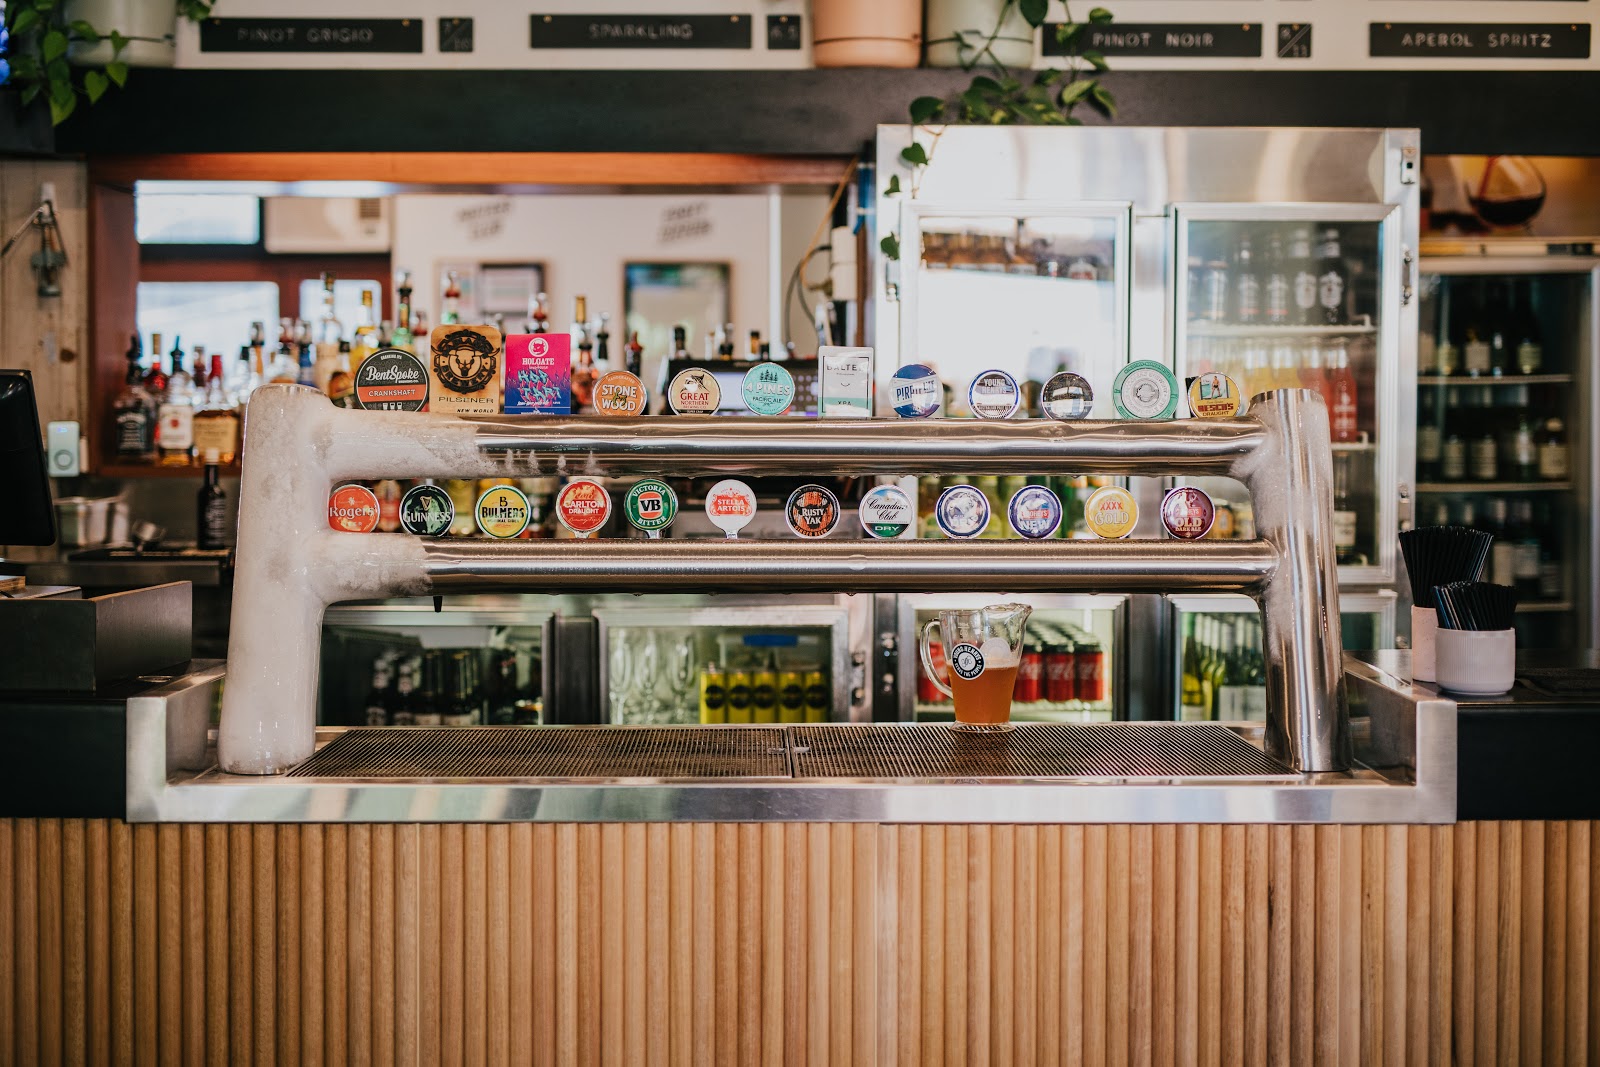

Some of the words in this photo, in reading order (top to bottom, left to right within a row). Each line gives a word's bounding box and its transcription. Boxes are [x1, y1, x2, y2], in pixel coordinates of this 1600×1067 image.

[238, 27, 296, 42] PINOT
[306, 27, 374, 43] GRIGIO
[588, 24, 694, 40] SPARKLING
[1092, 32, 1152, 48] PINOT
[1165, 32, 1214, 48] NOIR
[1401, 32, 1474, 48] APEROL
[1488, 32, 1552, 48] SPRITZ
[522, 357, 555, 366] HOLGATE
[826, 363, 864, 372] BALTE
[365, 365, 419, 384] BentSpoke
[983, 378, 1006, 387] YOUNG
[368, 389, 416, 398] CRANKSHAFT
[601, 384, 638, 398] STONE
[746, 382, 754, 393] 4
[756, 382, 790, 396] PINES
[438, 396, 494, 404] PILSENER
[680, 392, 709, 400] GREAT
[601, 398, 637, 411] WOOD
[632, 484, 667, 497] VICTORIA
[563, 500, 604, 509] CARLTON
[640, 499, 662, 512] VB
[1099, 501, 1123, 511] XXXX
[402, 510, 451, 523] GUINNESS
[481, 506, 525, 518] BULMERS
[802, 508, 825, 517] RUSTY
[877, 509, 900, 520] Club
[637, 515, 667, 526] BITTER
[804, 516, 822, 525] YAK
[1094, 511, 1130, 525] GOLD
[1175, 517, 1203, 527] OLD
